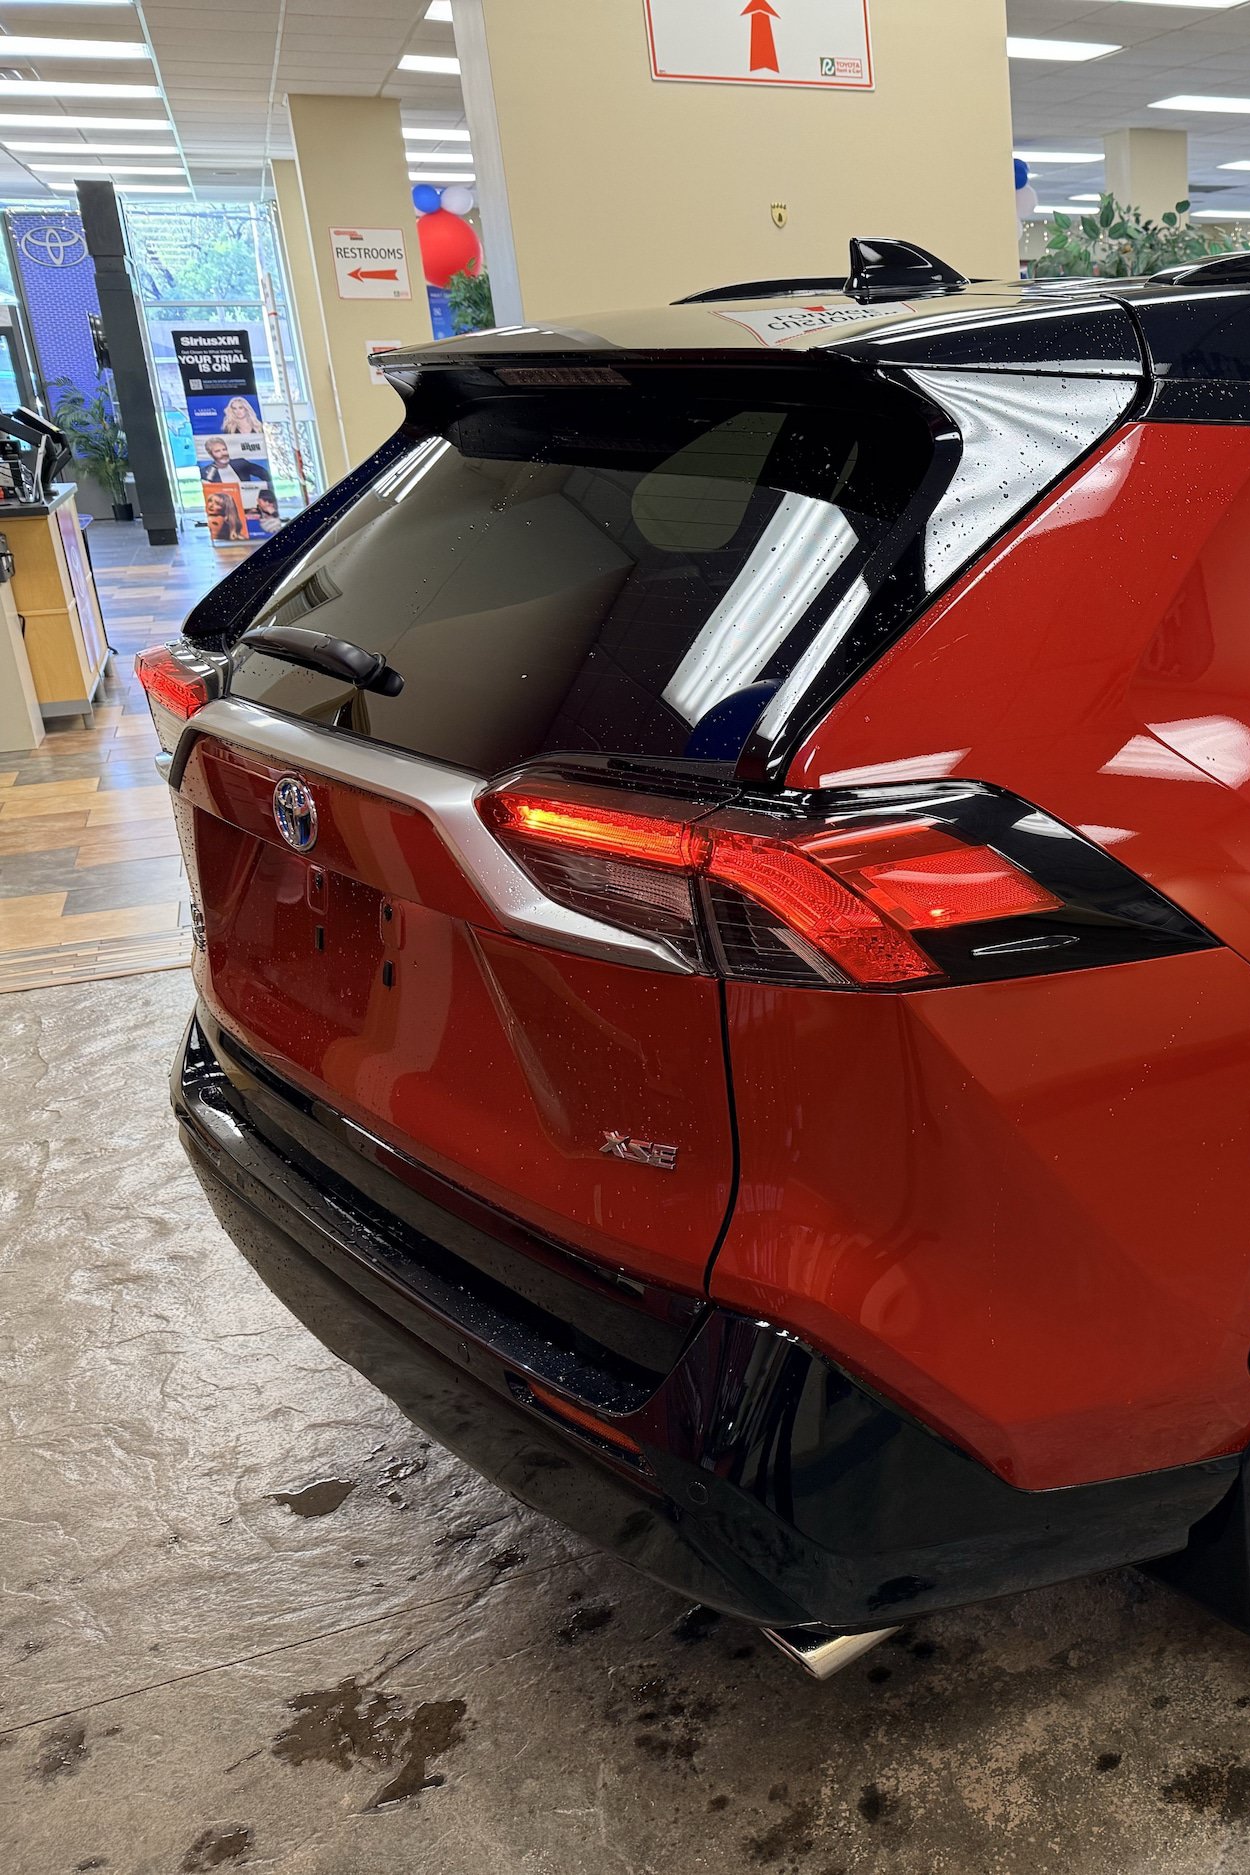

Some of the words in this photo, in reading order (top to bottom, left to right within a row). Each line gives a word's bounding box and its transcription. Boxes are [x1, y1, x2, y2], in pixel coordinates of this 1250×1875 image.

[335, 247, 403, 260] RESTROOMS
[180, 336, 239, 346] SiriusXM
[178, 355, 212, 364] YOUR
[213, 354, 248, 363] TRIAL
[198, 363, 211, 373] IS
[212, 363, 231, 372] ON
[599, 1130, 679, 1170] XSE
